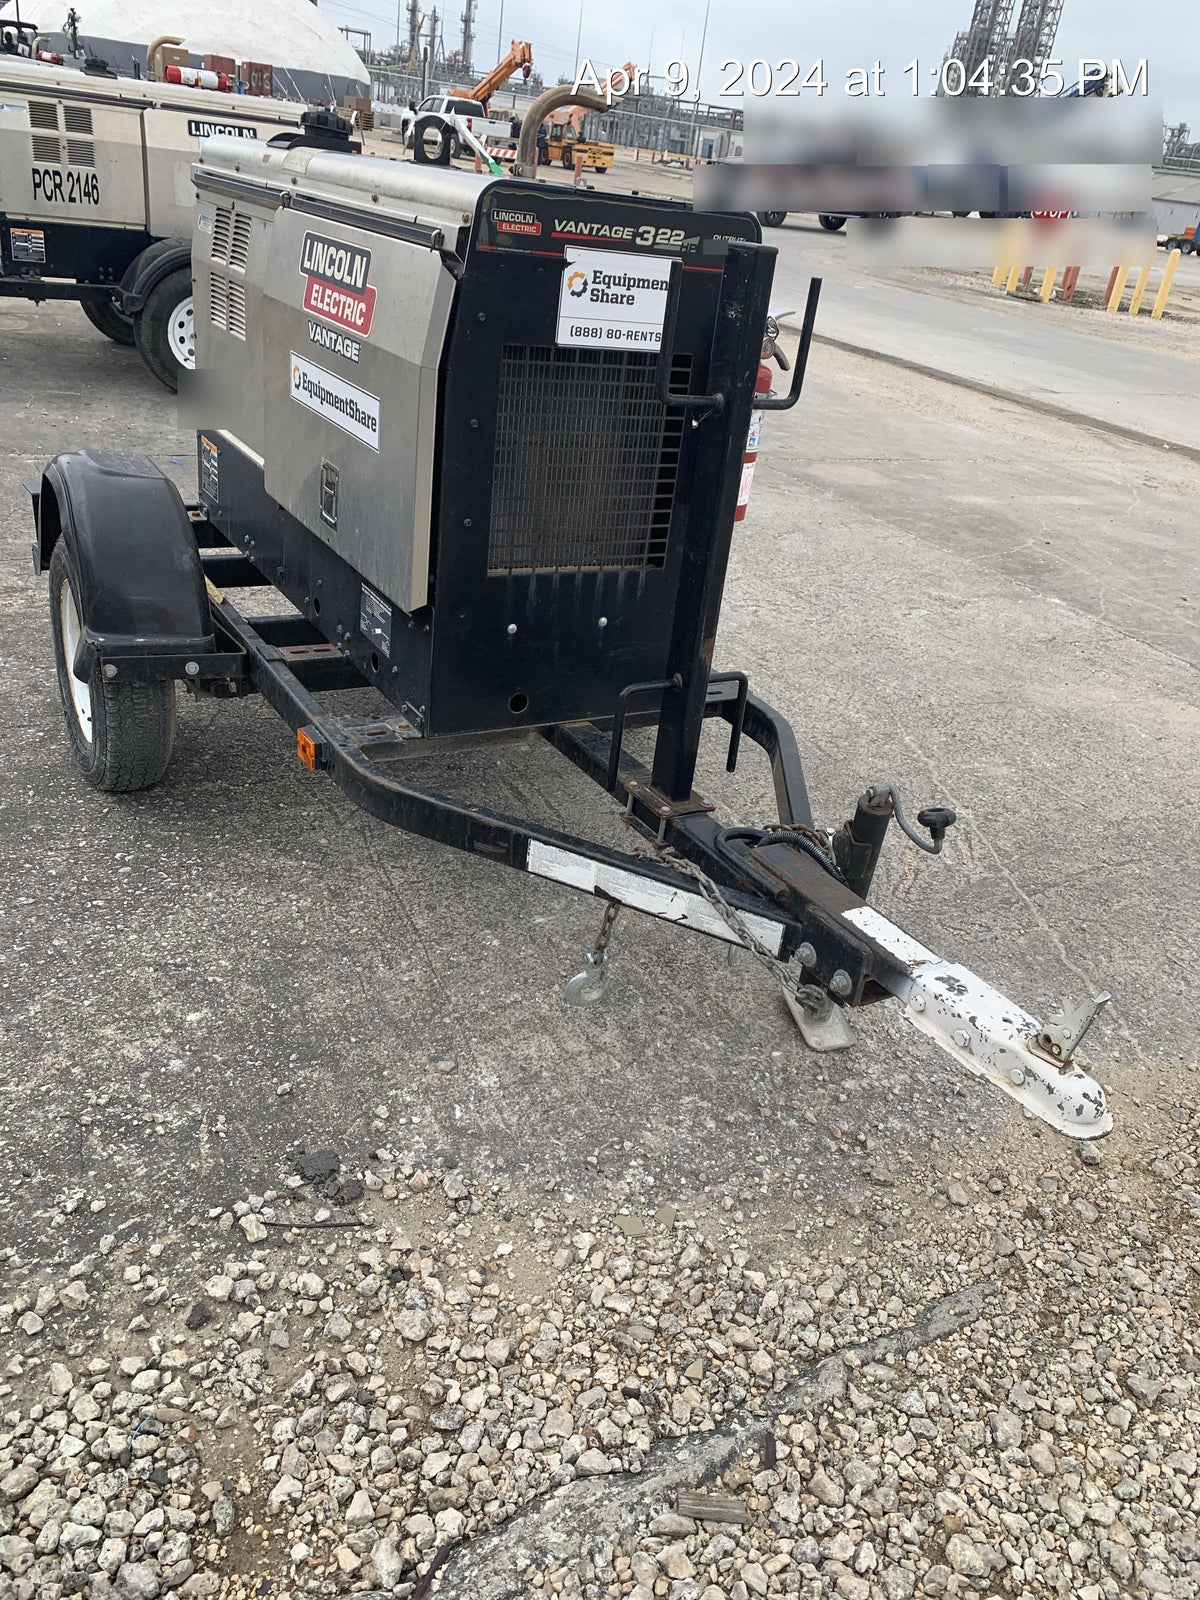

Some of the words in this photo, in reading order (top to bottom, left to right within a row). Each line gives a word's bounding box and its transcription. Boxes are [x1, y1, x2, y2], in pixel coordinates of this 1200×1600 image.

[32, 168, 65, 202] PCR
[67, 171, 99, 205] 2146
[493, 211, 533, 223] LINCOLN
[502, 223, 537, 233] ELECTRIC
[555, 219, 633, 239] VANTAGE
[635, 226, 685, 245] 322
[303, 239, 366, 289] LINCOLN
[592, 270, 669, 291] Equipmen
[310, 284, 366, 325] ELECTRIC
[590, 288, 635, 306] Share
[308, 321, 361, 363] VANTAGE
[570, 325, 602, 339] (888)
[607, 328, 662, 342] 80-RENTS
[302, 371, 377, 433] EquipmentShare
